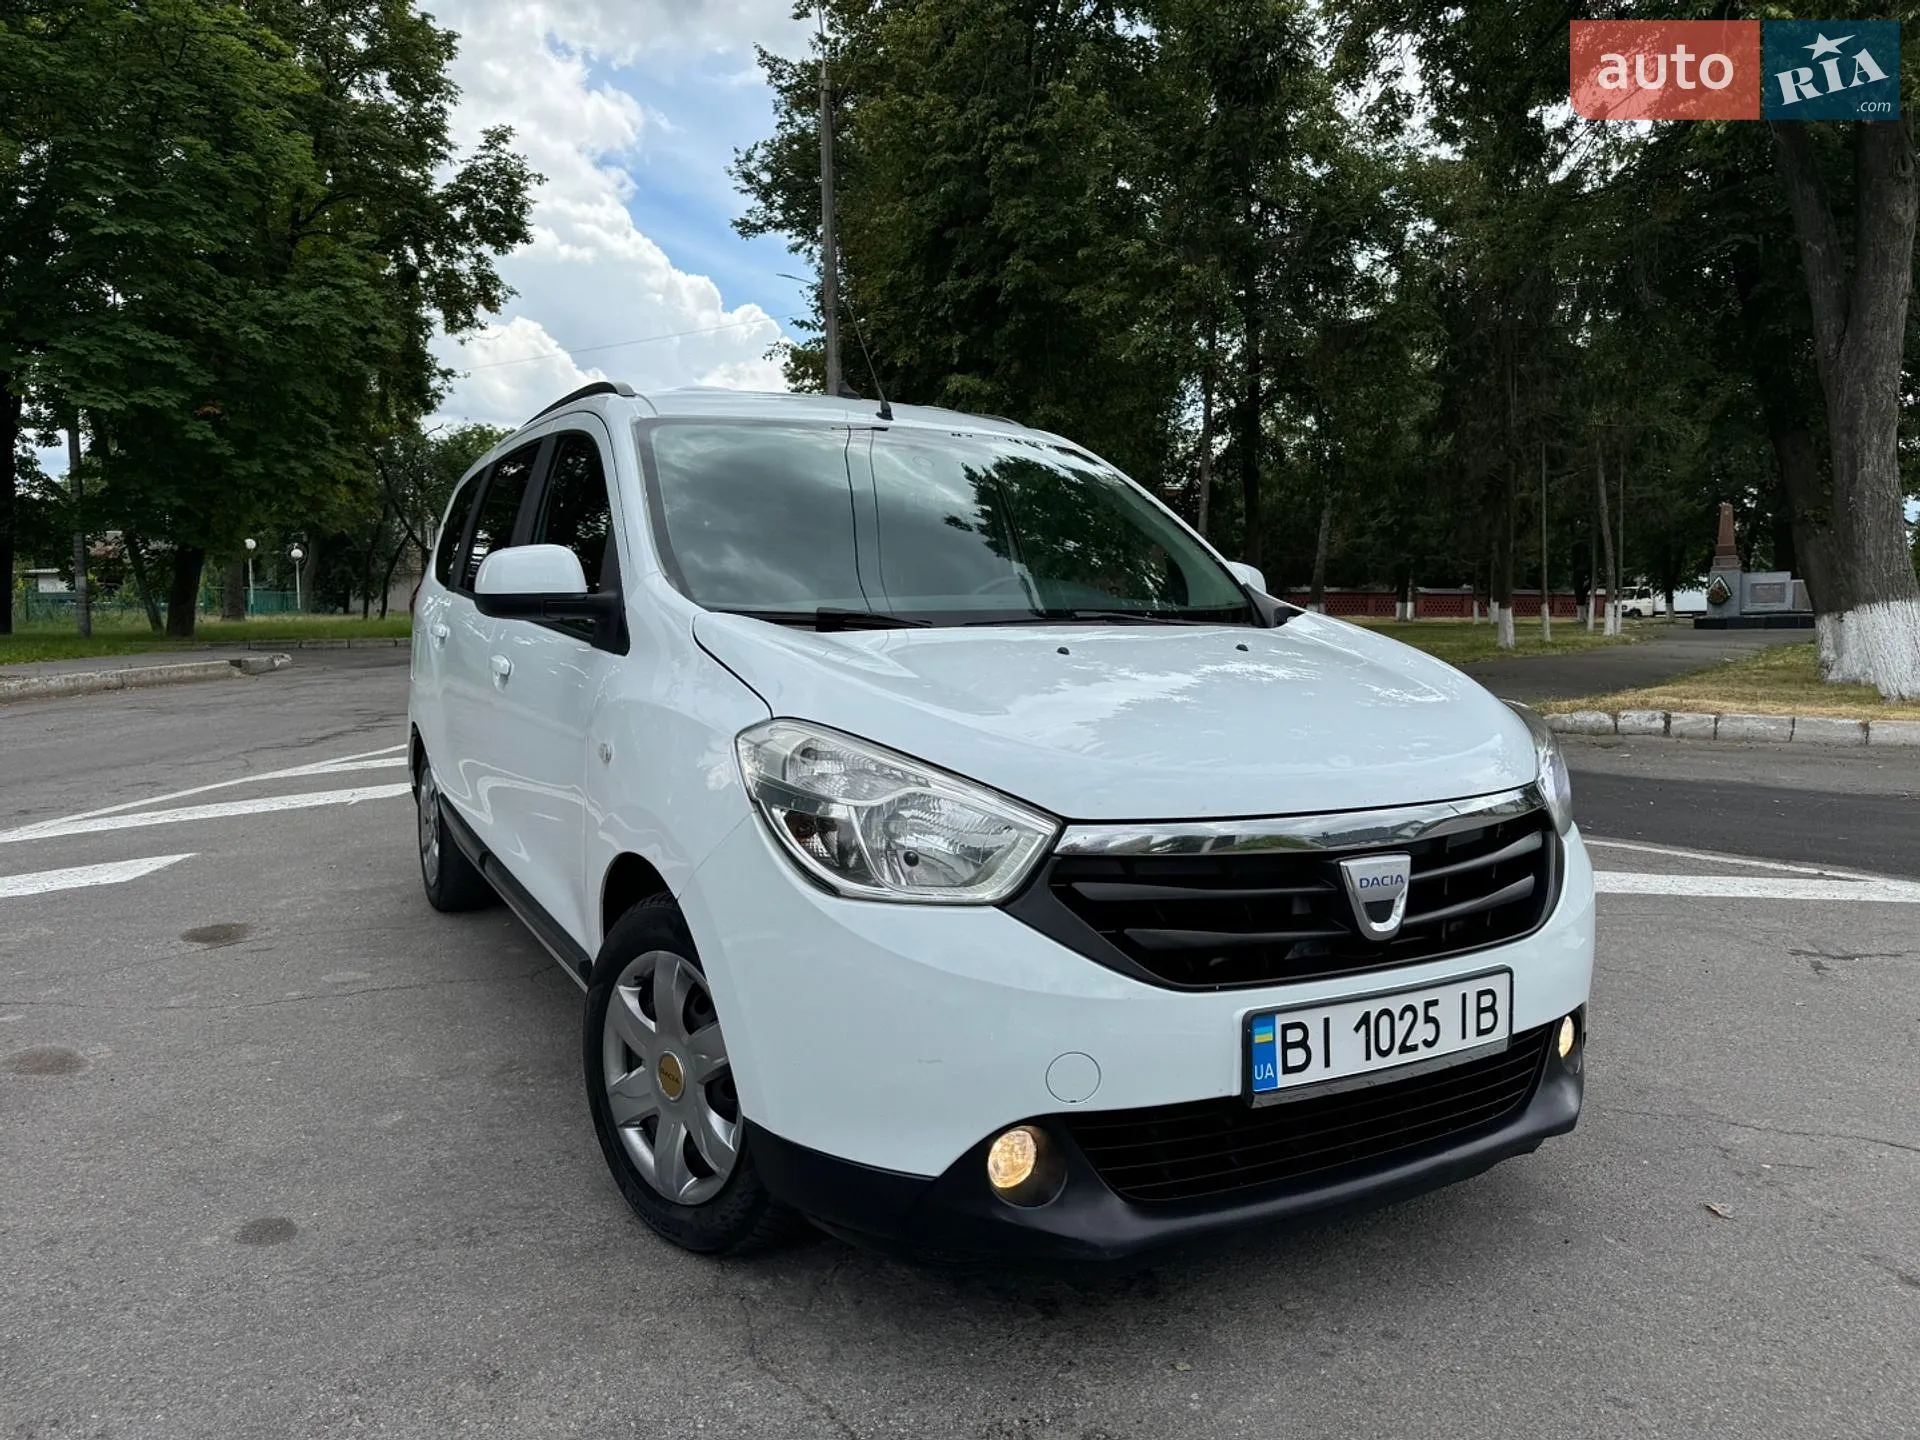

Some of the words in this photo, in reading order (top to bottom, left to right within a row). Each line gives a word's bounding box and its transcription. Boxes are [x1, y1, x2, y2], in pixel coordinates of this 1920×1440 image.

[1360, 874, 1404, 888] DACIA
[1281, 1016, 1331, 1075] BI
[1353, 999, 1440, 1061] 1025
[1461, 987, 1498, 1040] IB
[1254, 1063, 1275, 1081] UA
